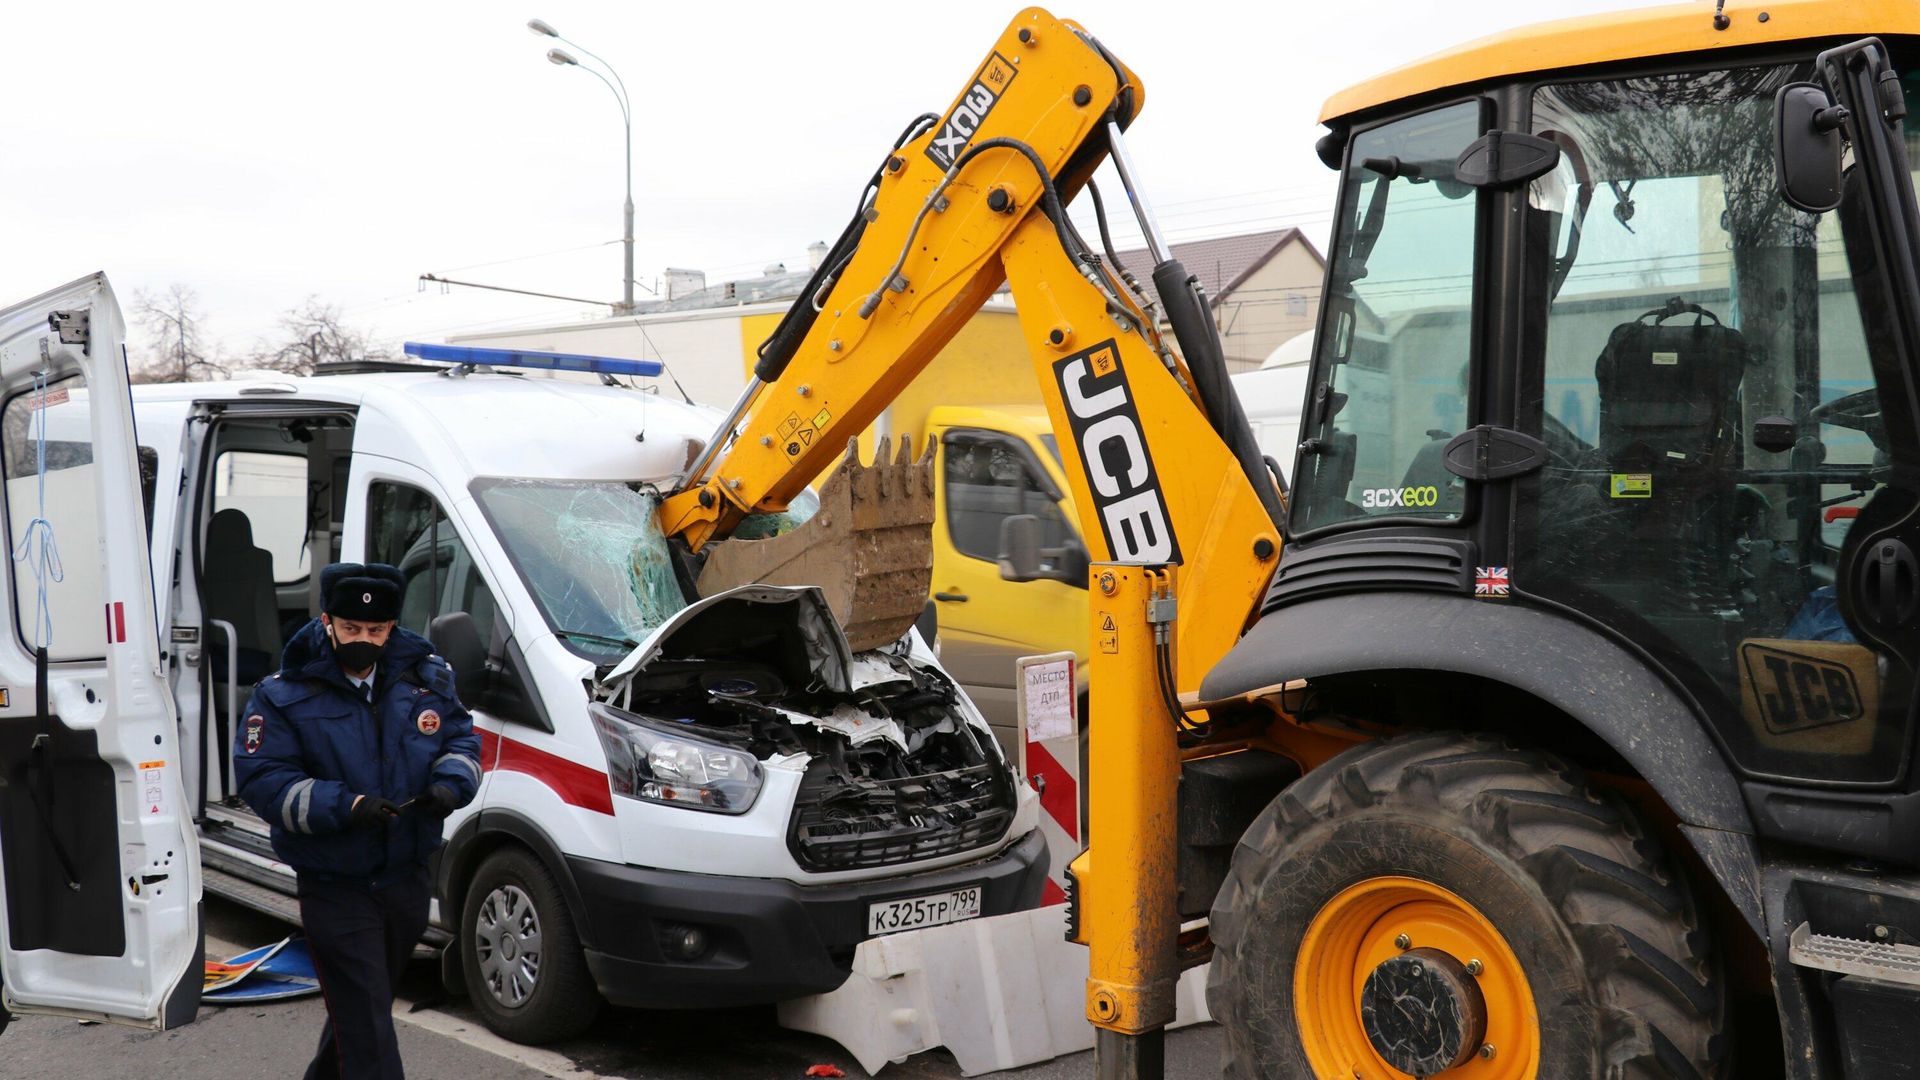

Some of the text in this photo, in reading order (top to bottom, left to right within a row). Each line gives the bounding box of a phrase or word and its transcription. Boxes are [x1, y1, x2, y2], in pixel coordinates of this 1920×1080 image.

[933, 84, 994, 161] 3CX
[1062, 357, 1172, 562] JCB
[1033, 670, 1066, 685] МЕСТО
[1041, 691, 1060, 705] ДТП
[1763, 654, 1856, 725] JCB
[875, 889, 977, 931] К325ТР 799
